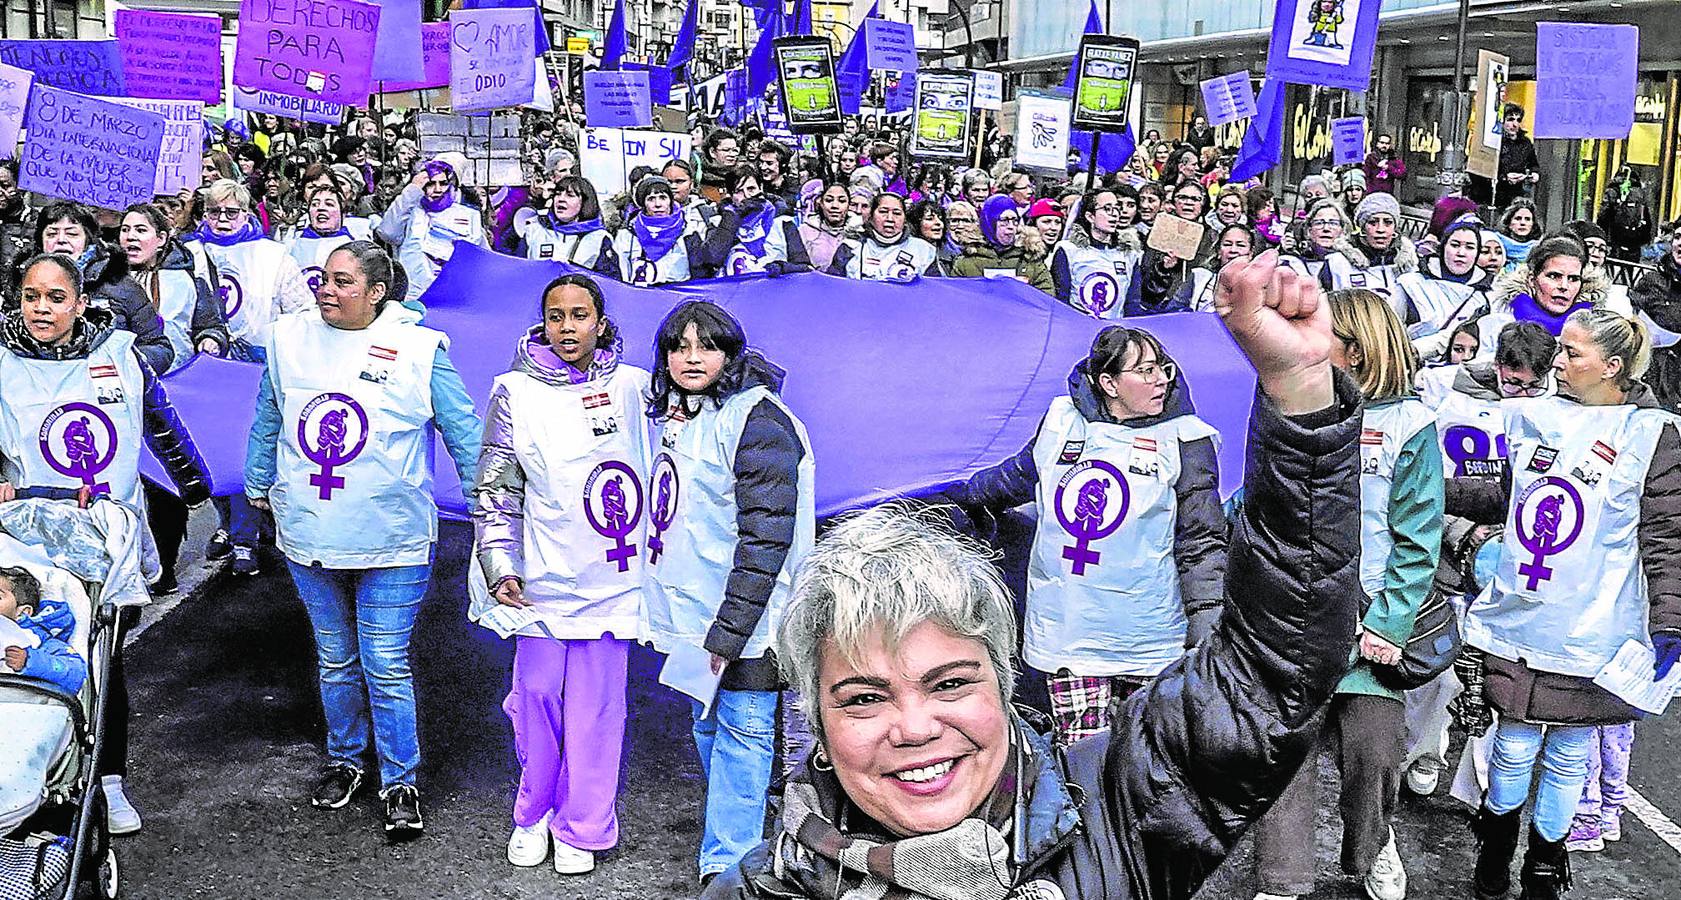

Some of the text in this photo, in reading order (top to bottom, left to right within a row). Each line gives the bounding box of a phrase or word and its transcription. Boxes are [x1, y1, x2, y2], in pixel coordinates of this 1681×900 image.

[250, 0, 375, 33] DERECHOS
[267, 29, 344, 63] PARA
[253, 57, 341, 92] TODS
[475, 73, 506, 92] ODIO
[258, 92, 341, 116] INMOBLIARIO
[38, 92, 59, 123] 8
[62, 105, 82, 124] DE
[90, 111, 149, 140] MARZO
[30, 143, 54, 162] DE
[587, 135, 610, 151] BE
[625, 140, 646, 156] IN
[26, 160, 58, 178] QUE
[1464, 460, 1506, 476] BERDIN
[1014, 881, 1038, 894] THE
